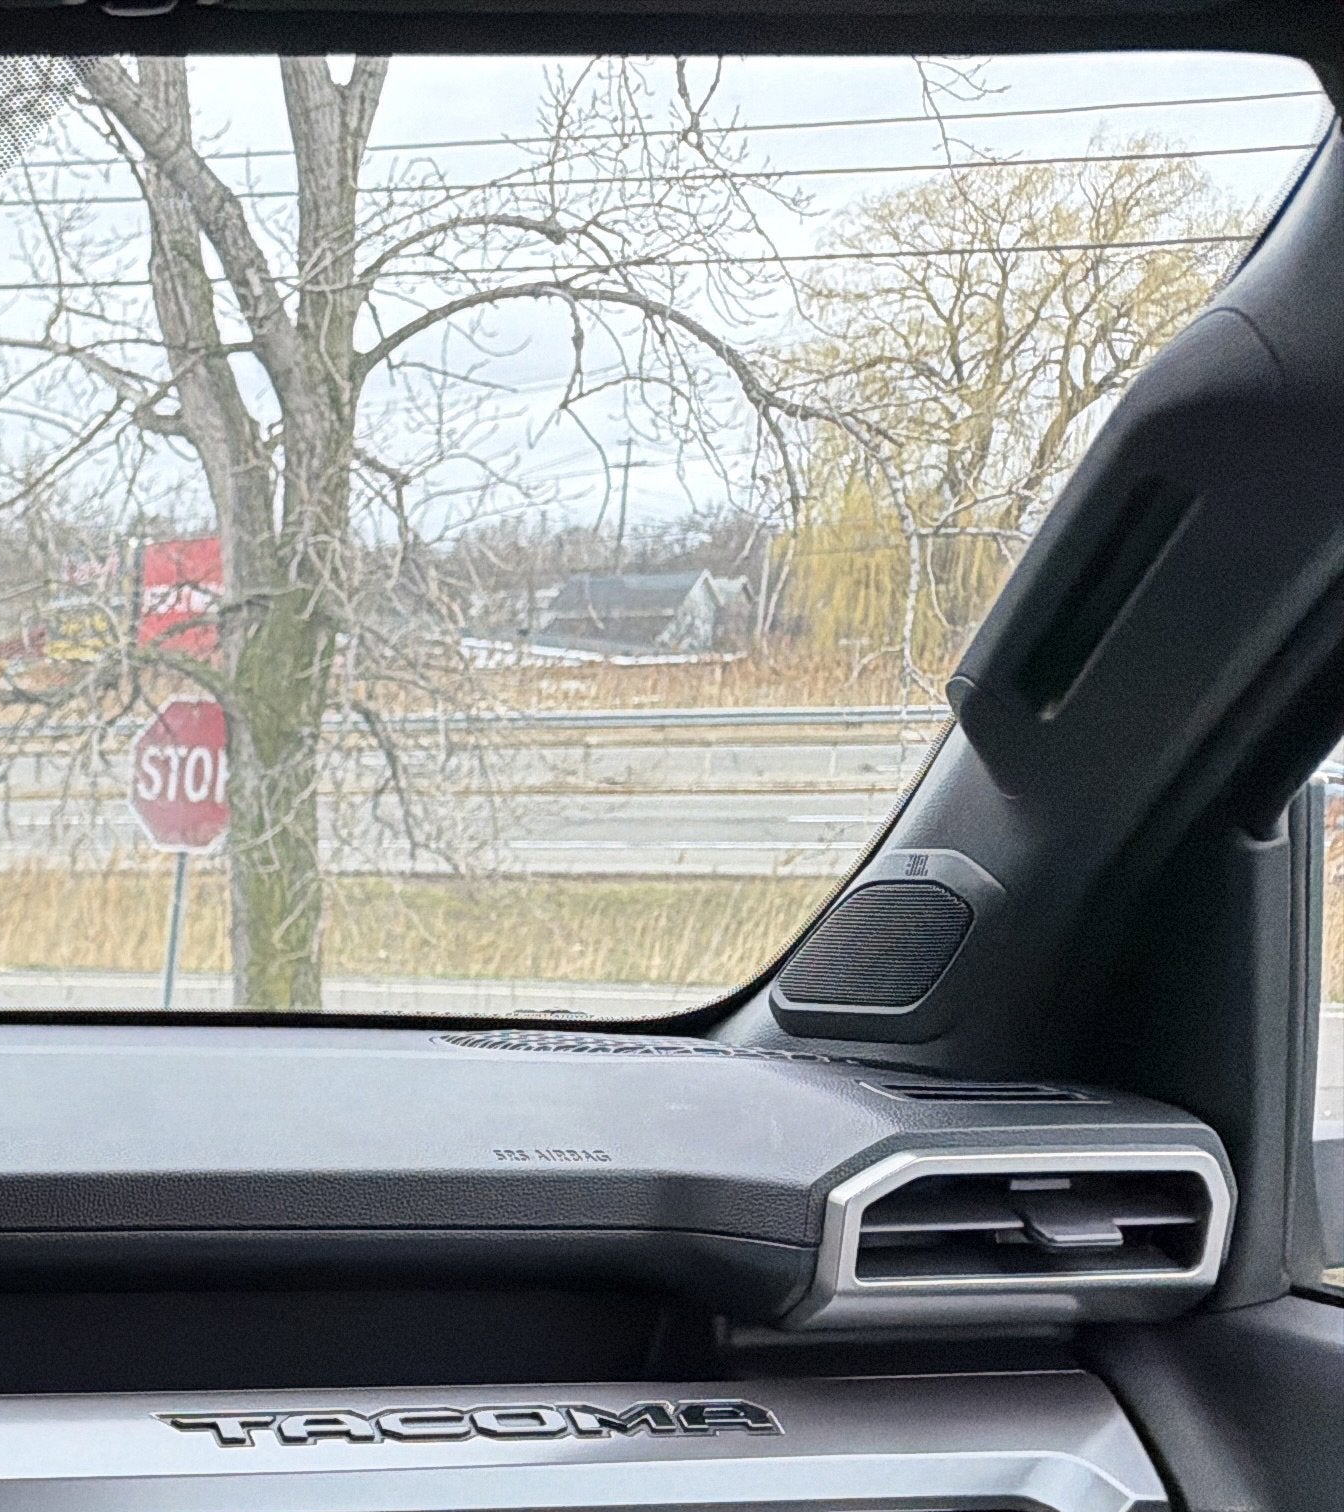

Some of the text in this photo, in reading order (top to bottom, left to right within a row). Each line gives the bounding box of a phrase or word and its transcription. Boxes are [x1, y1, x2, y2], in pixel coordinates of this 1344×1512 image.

[492, 1149, 612, 1162] SRS AIRBAG
[150, 1400, 786, 1449] TACOMA
